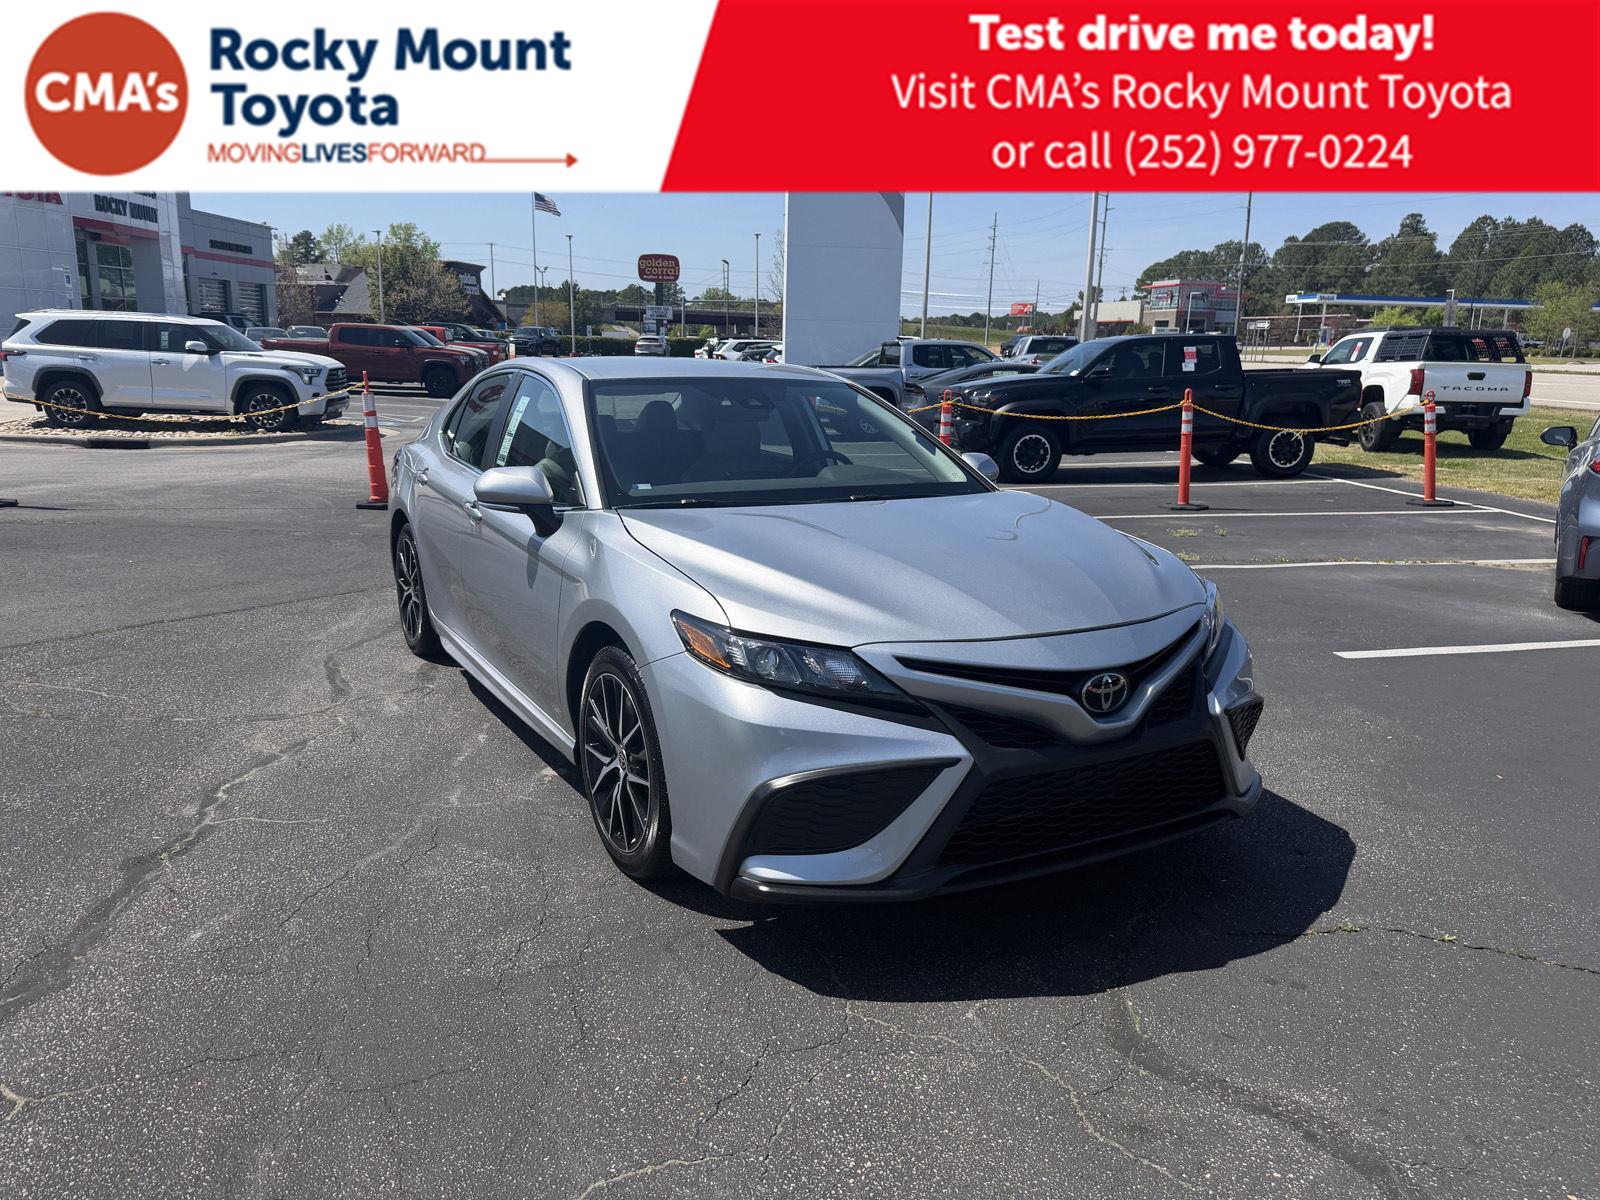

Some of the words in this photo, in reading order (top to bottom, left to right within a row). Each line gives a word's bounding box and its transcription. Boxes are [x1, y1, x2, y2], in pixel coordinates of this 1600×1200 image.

[93, 193, 128, 217] ROCKY
[129, 201, 159, 224] MOUNT
[639, 258, 675, 269] golden
[645, 266, 679, 275] corral
